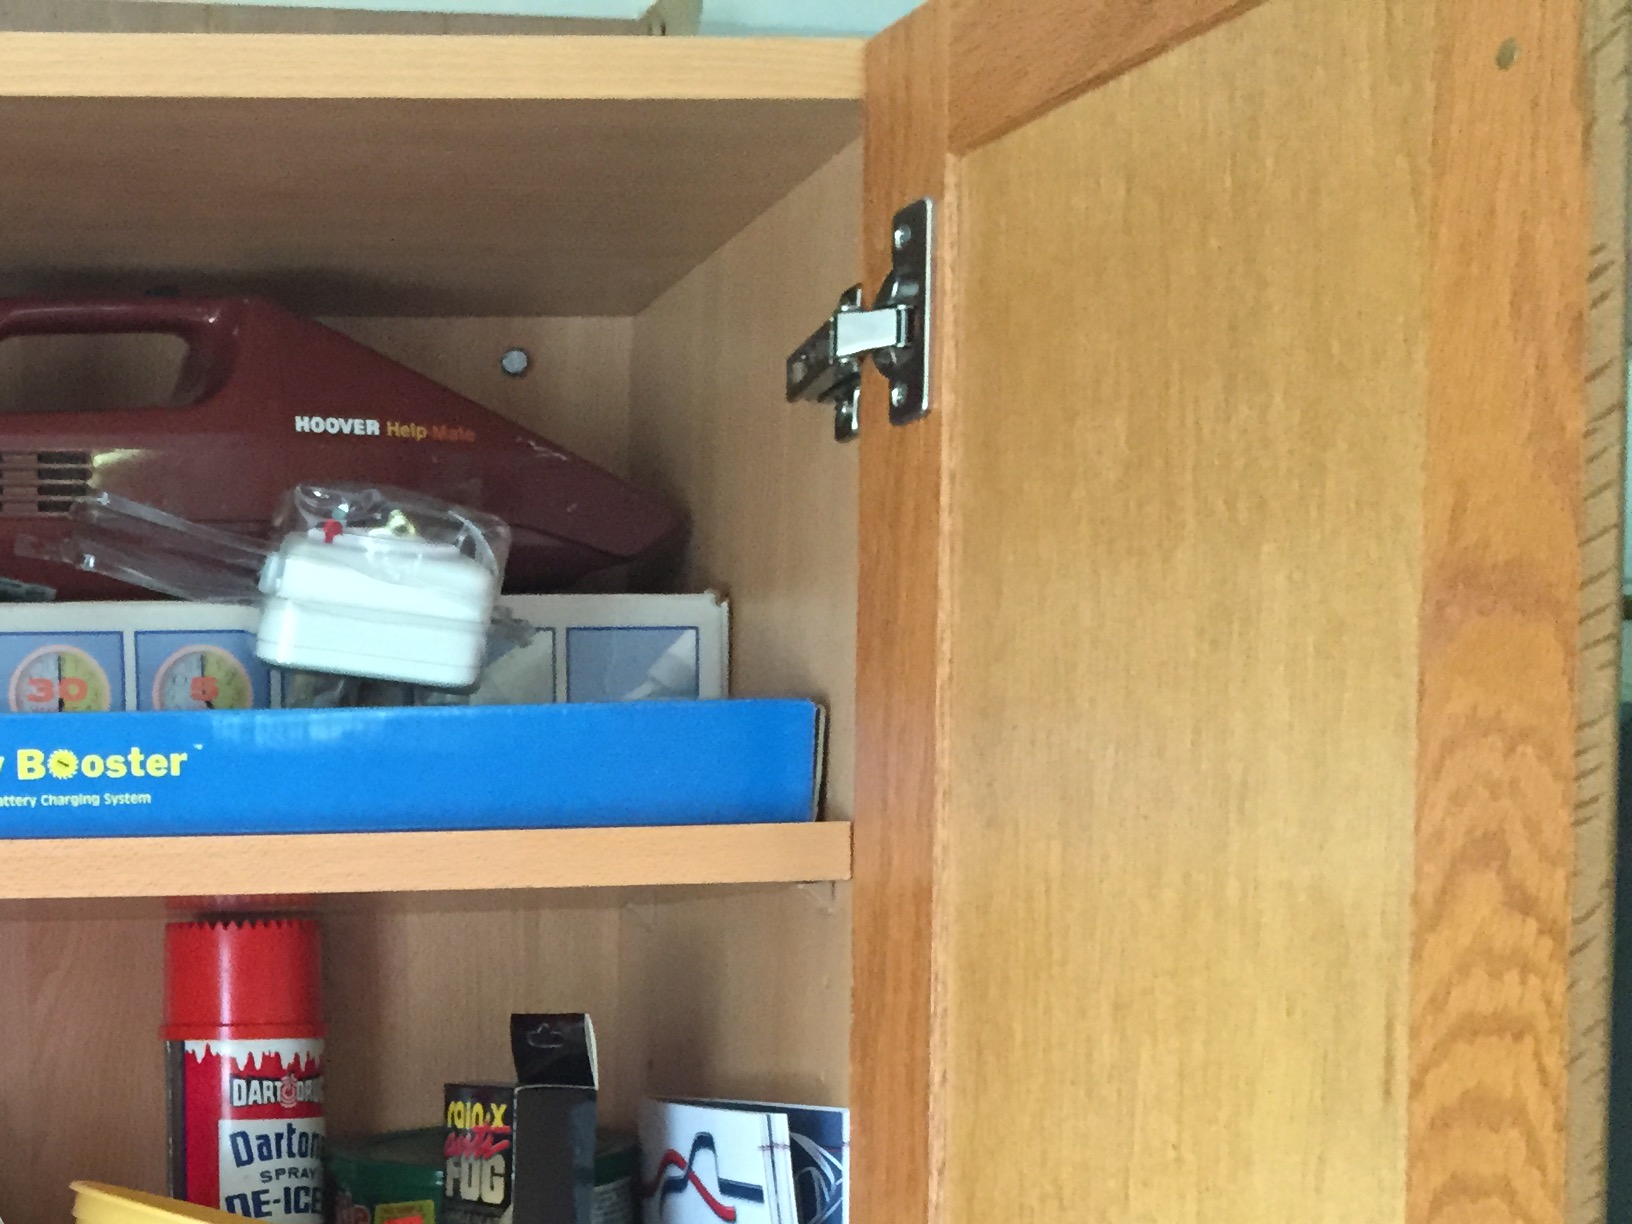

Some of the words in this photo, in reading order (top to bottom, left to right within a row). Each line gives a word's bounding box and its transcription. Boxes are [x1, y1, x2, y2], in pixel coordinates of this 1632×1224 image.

[295, 416, 380, 435] HOOVER
[386, 420, 428, 441] Help
[17, 746, 188, 781] Booster
[40, 792, 101, 808] Charging
[104, 791, 152, 806] System
[259, 1166, 317, 1184] SPRAY
[445, 1153, 506, 1205] FOG
